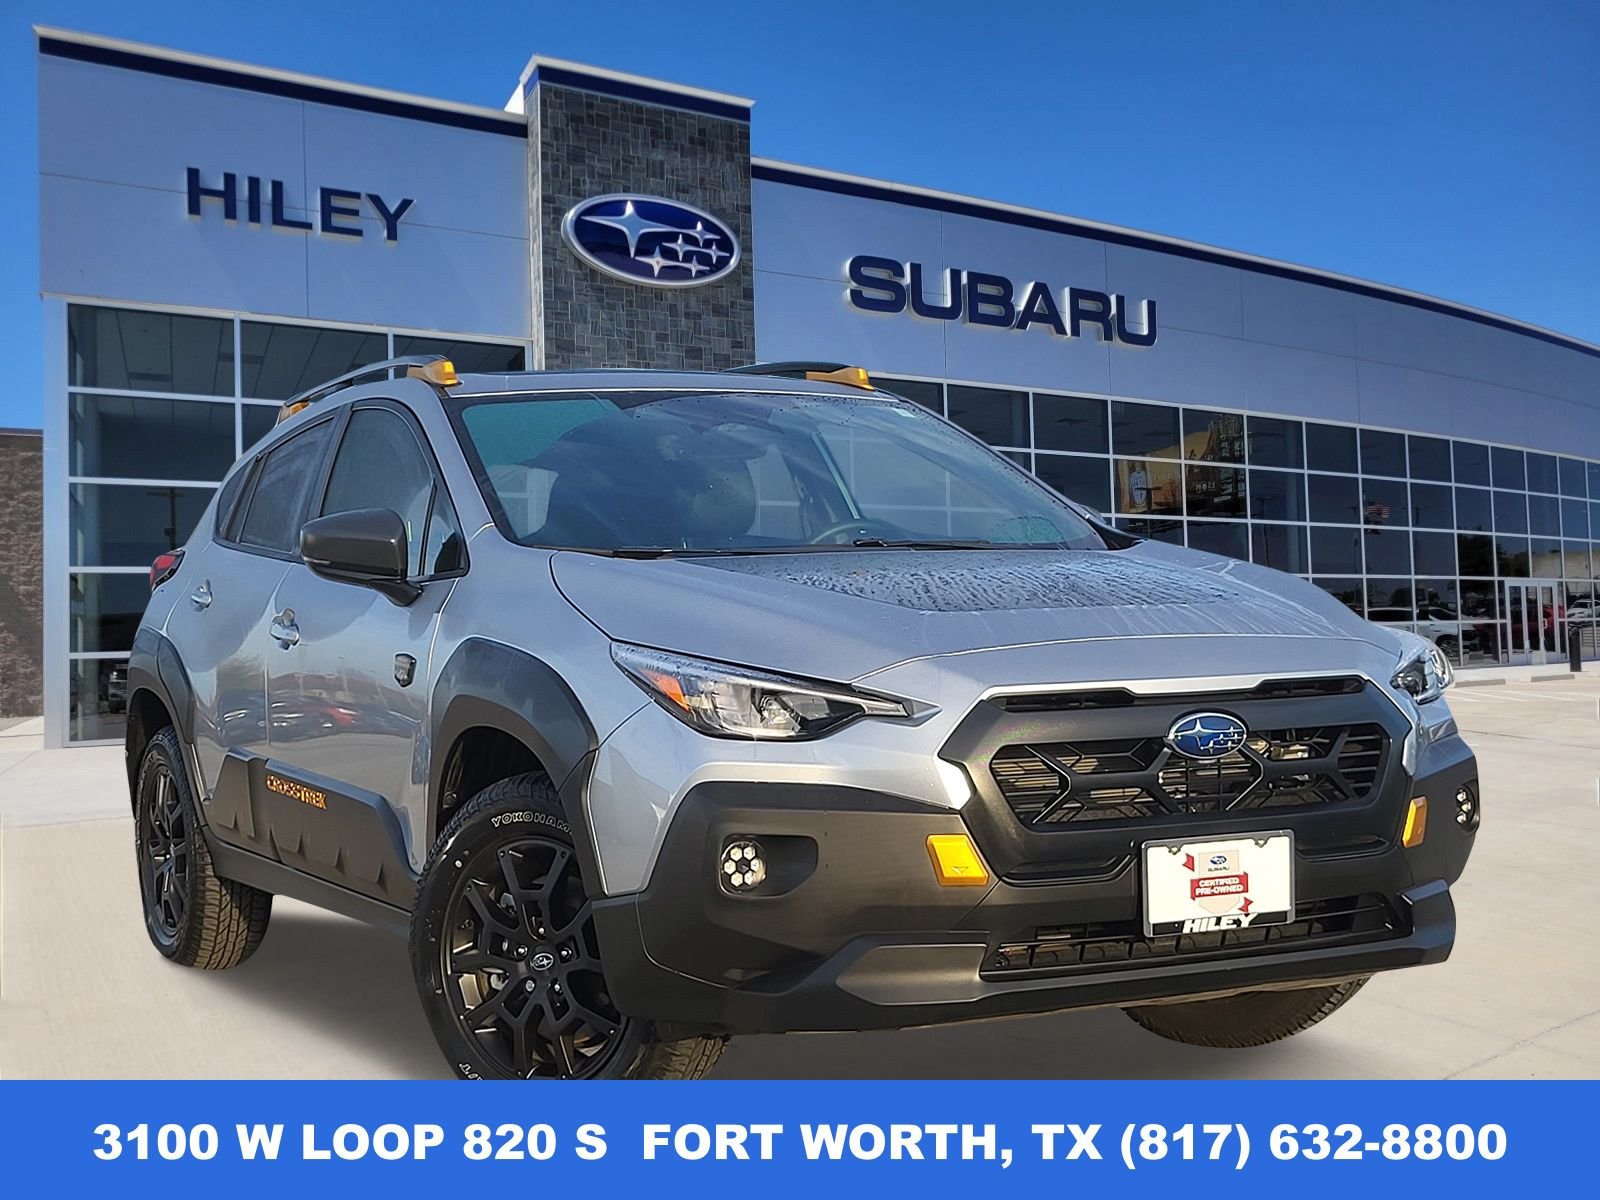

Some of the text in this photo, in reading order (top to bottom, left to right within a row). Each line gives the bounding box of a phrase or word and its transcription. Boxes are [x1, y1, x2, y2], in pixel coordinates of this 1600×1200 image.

[186, 167, 415, 243] HILEY
[848, 254, 1158, 348] SUBARU
[266, 775, 328, 810] CROSSTREK
[491, 811, 573, 836] YOKOHAM
[1195, 884, 1245, 897] PRE-OWNED
[1198, 877, 1240, 888] CERTIFIED
[1181, 911, 1259, 935] HILEY
